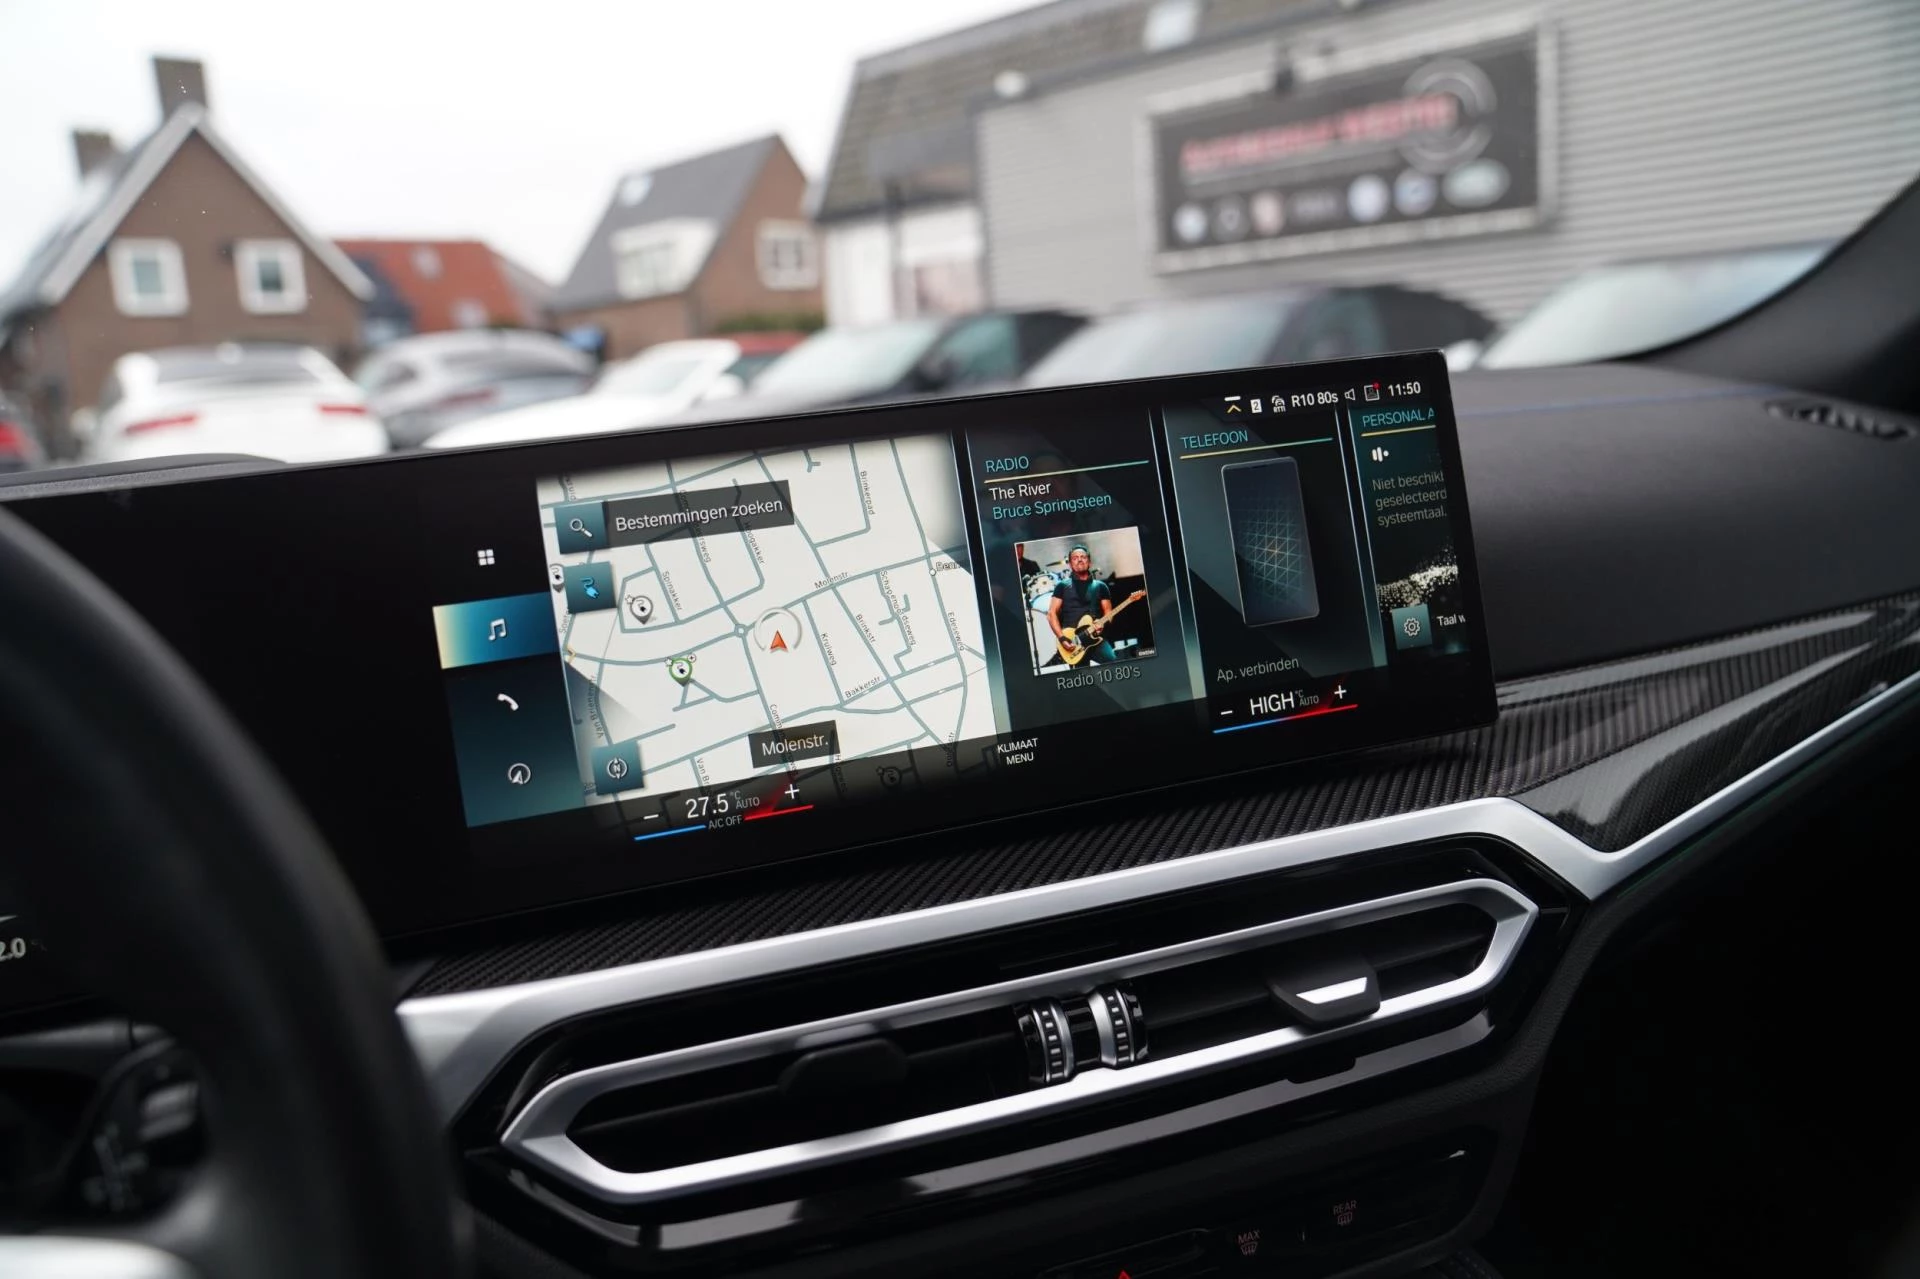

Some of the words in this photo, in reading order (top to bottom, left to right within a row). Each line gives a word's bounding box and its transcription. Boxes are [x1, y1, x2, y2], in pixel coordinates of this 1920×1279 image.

[1387, 381, 1421, 397] 11:50
[1291, 394, 1316, 408] R10
[1317, 391, 1339, 405] 80s
[1362, 408, 1426, 427] PERSONAL
[1180, 430, 1249, 449] TELEFOON
[985, 455, 1030, 473] RADIO
[989, 486, 1015, 501] The
[1018, 482, 1051, 497] River
[1372, 477, 1396, 491] Niet
[615, 505, 728, 532] Bestemmingen
[731, 499, 783, 517] zoeken
[992, 503, 1032, 520] Bruce
[1034, 493, 1112, 516] Springsteen
[1376, 505, 1447, 528] systeemtaal.
[814, 571, 849, 589] Molenstr
[855, 614, 877, 644] Brinkstr
[1436, 614, 1457, 626] Taal
[1056, 672, 1095, 690] Radio
[1097, 669, 1112, 684] 10
[1115, 664, 1142, 680] 80's
[1217, 668, 1238, 684] Ap.
[1239, 657, 1300, 678] verbinden
[844, 675, 881, 699] Bakkerstr
[1249, 691, 1295, 716] HIGH
[1299, 695, 1320, 707] AUTO
[761, 733, 829, 757] Molenstr.
[997, 737, 1039, 754] KLIMAAT
[1006, 752, 1035, 766] MENU
[685, 793, 729, 819] 27.5
[735, 796, 760, 809] AUTO
[708, 817, 724, 830] A/C
[725, 815, 743, 828] OFF
[1332, 1200, 1357, 1216] REAR
[1237, 1230, 1261, 1245] MAX
